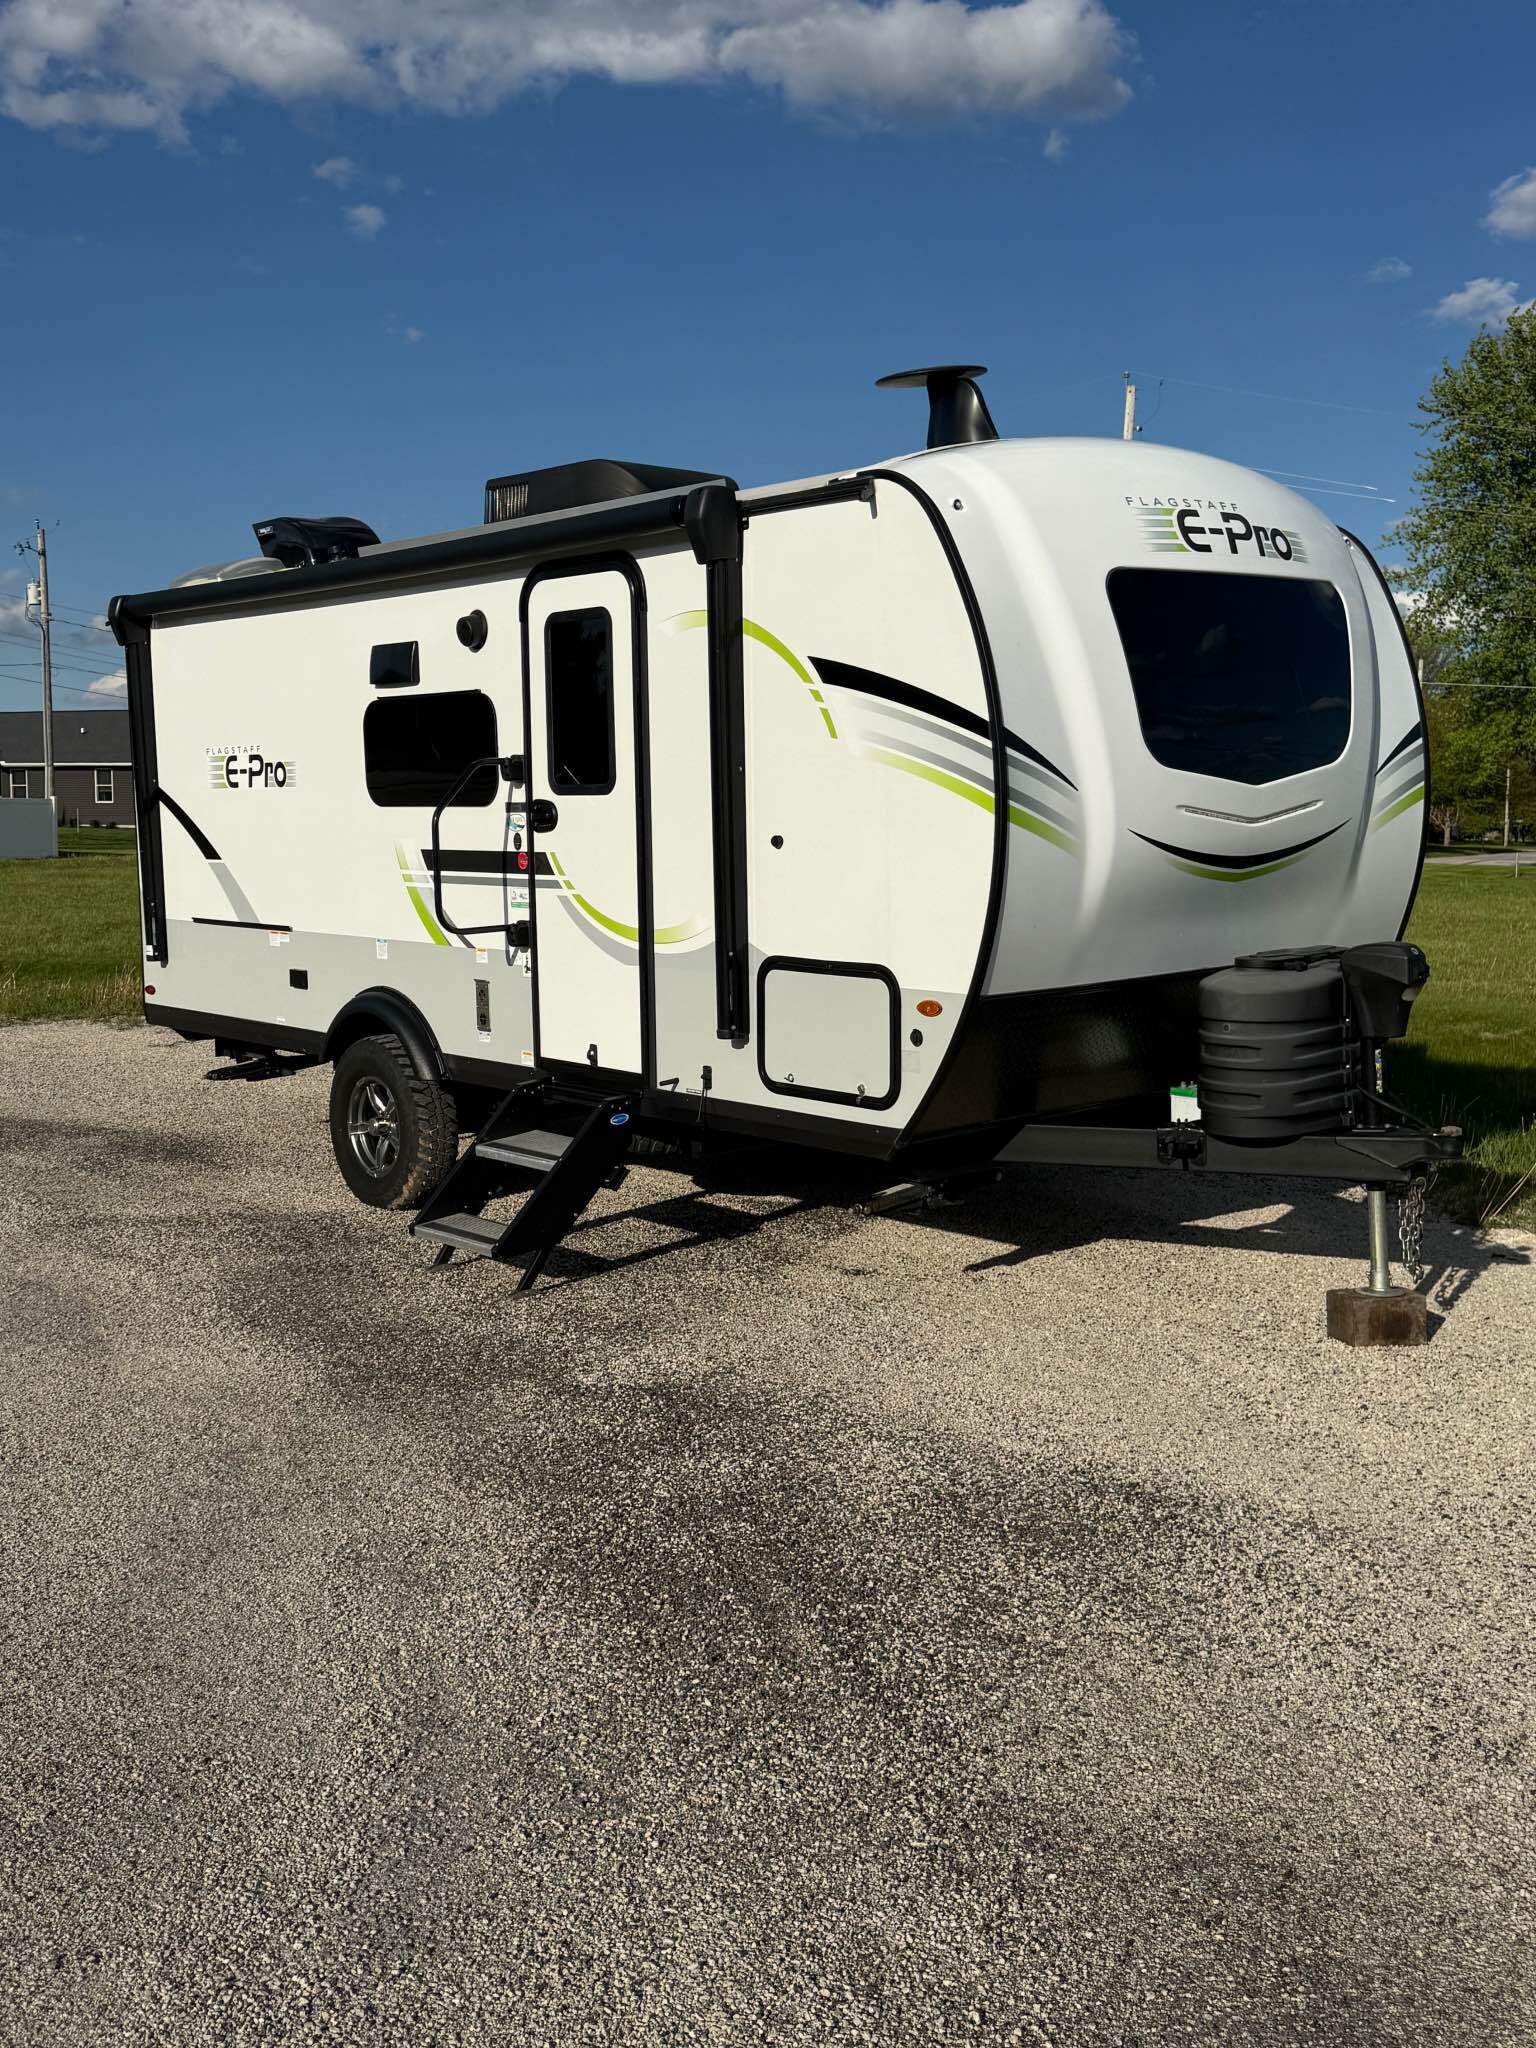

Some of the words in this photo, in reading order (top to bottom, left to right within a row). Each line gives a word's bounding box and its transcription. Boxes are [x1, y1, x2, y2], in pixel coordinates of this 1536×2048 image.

[1125, 496, 1240, 511] FLAGSTAFF
[1176, 509, 1293, 561] E-Pro
[206, 745, 261, 755] FLAGSTAFF
[225, 754, 287, 788] E-Pro
